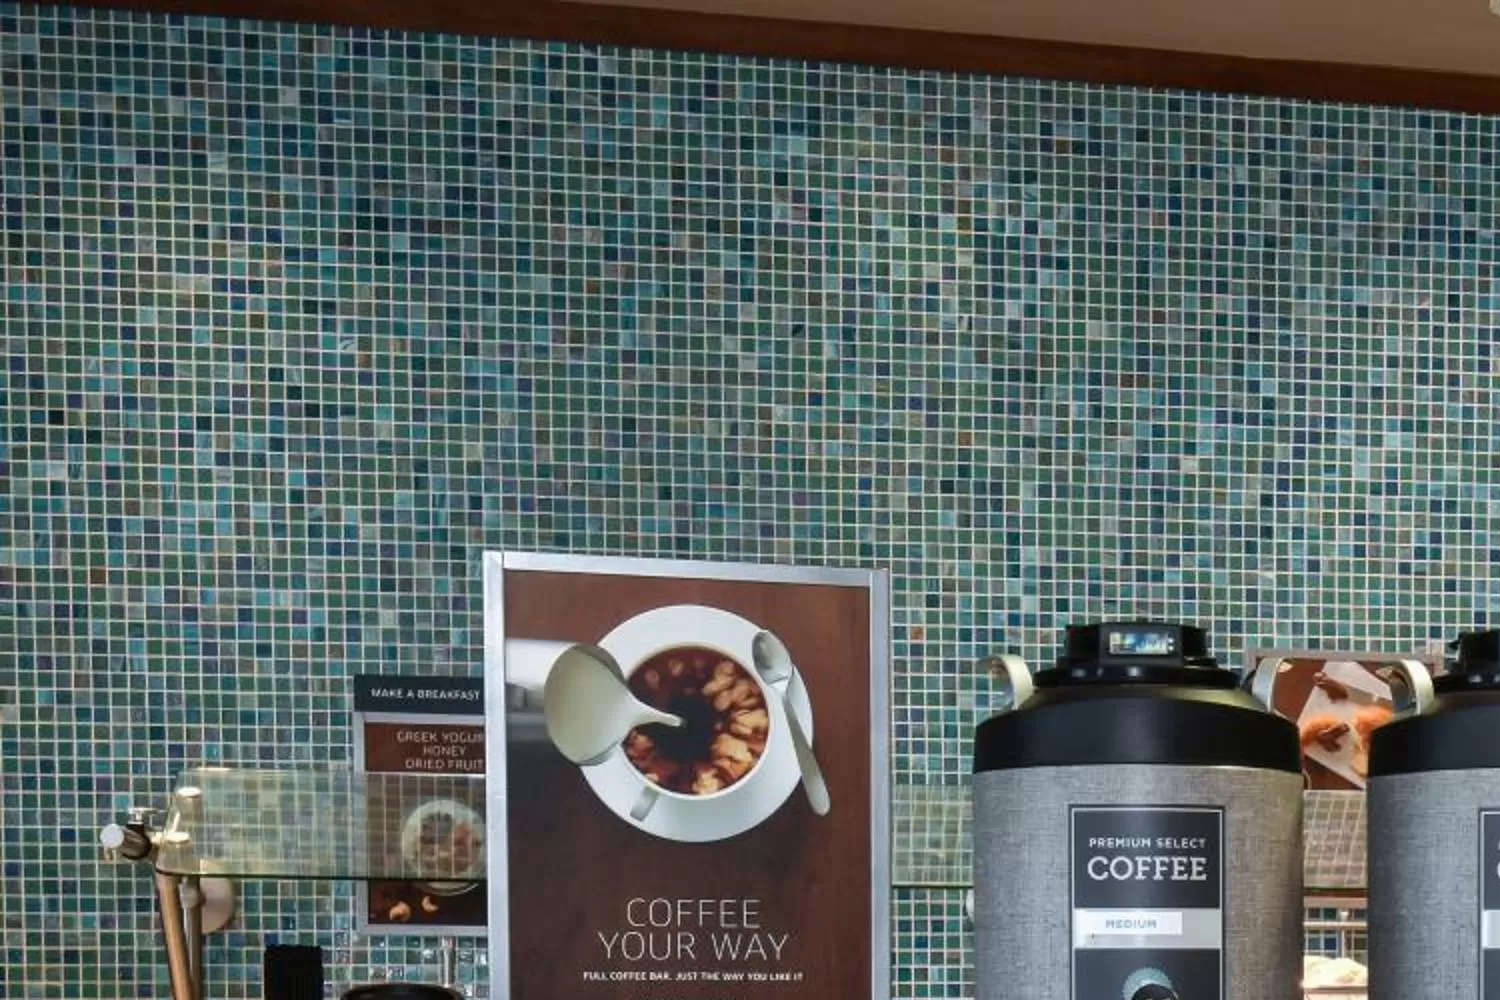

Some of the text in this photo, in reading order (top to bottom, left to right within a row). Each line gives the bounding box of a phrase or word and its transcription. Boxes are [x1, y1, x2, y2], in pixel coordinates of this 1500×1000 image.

[371, 688, 480, 700] MAKE A BREAKFAST
[396, 731, 438, 743] GREEK
[423, 745, 466, 757] HONEY
[405, 759, 444, 770] DRIED
[1089, 837, 1206, 849] PREMIUM SELECT
[1087, 855, 1207, 881] COFFEE
[626, 898, 761, 929] COFFEE
[1105, 920, 1157, 929] MEDIUM
[597, 931, 789, 961] YOUR WAY
[583, 971, 608, 981] FULL
[609, 971, 647, 981] COFFEE
[675, 971, 698, 981] JUST
[700, 971, 720, 981] THE
[722, 972, 745, 981] WAY
[747, 972, 768, 981] YOU
[769, 972, 791, 981] LIKE
